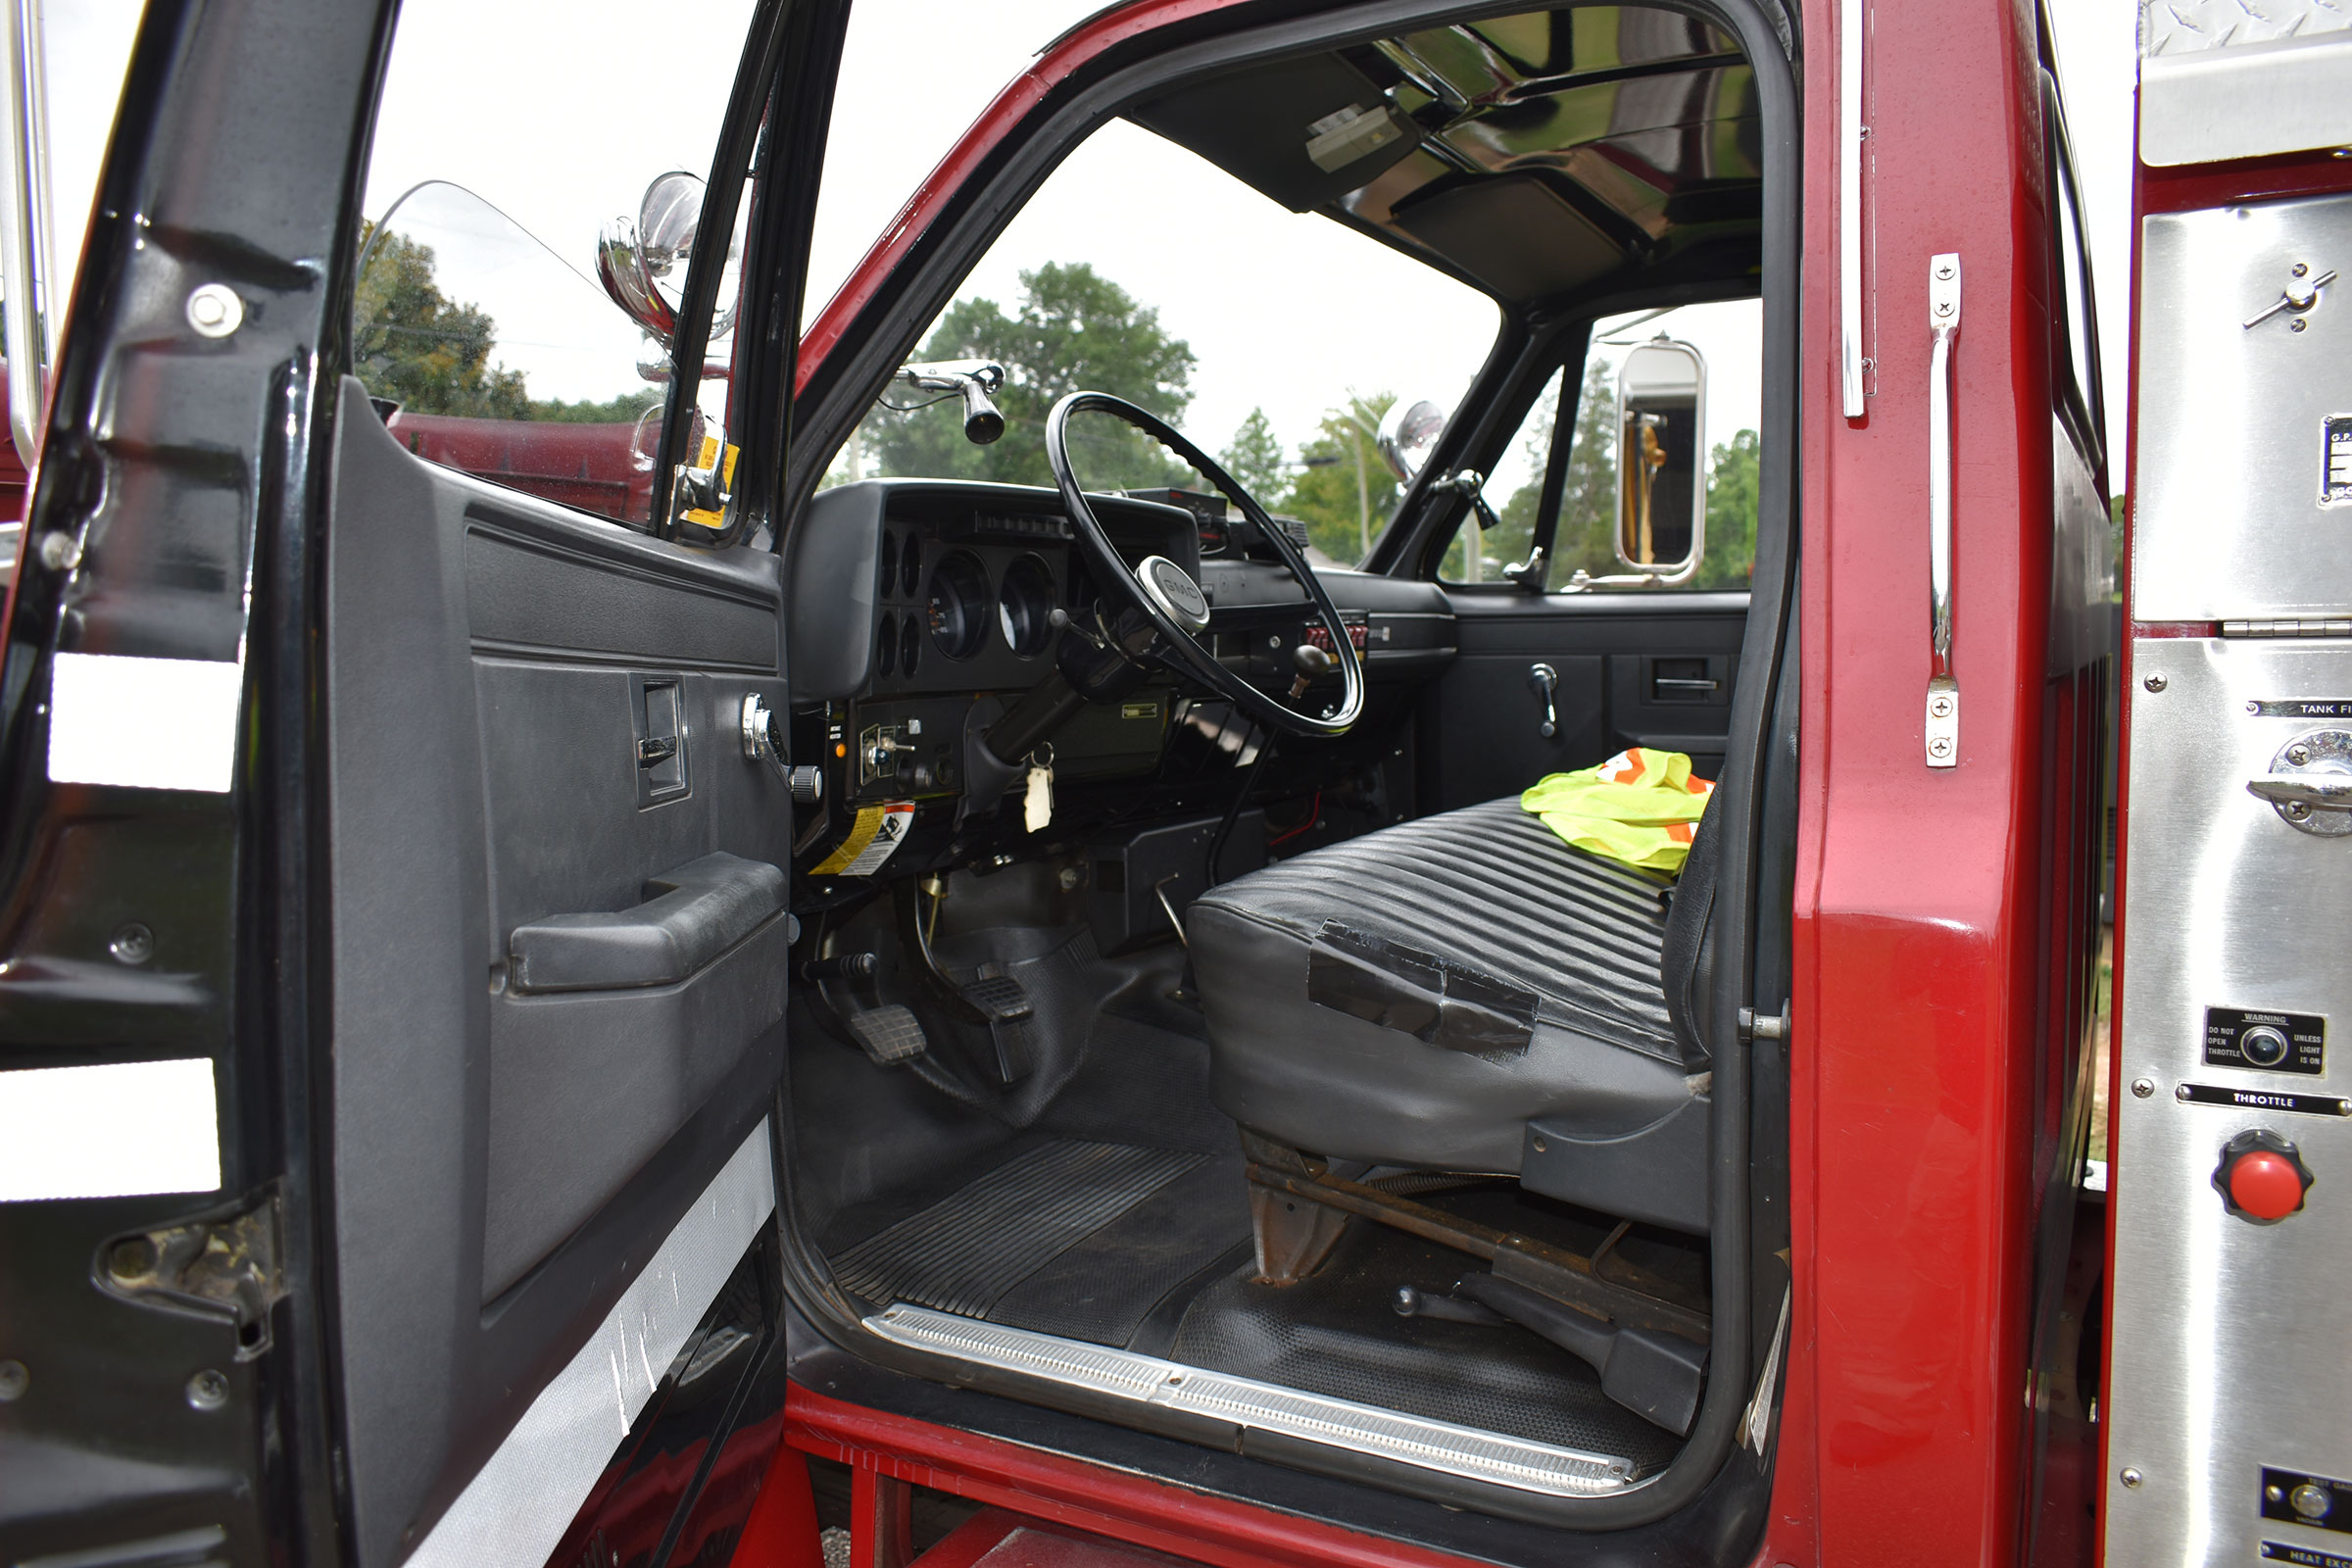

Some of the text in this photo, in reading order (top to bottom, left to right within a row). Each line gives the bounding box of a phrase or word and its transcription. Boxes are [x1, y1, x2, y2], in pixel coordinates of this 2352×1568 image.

[1163, 579, 1198, 599] GMC
[2299, 705, 2334, 713] TANK
[2244, 1012, 2286, 1023] WARNING
[2294, 1034, 2321, 1043] UNLESS
[2208, 1048, 2240, 1056] THROTTLE
[2233, 1093, 2294, 1107] THROTTLE
[2290, 1550, 2321, 1564] HEAT
